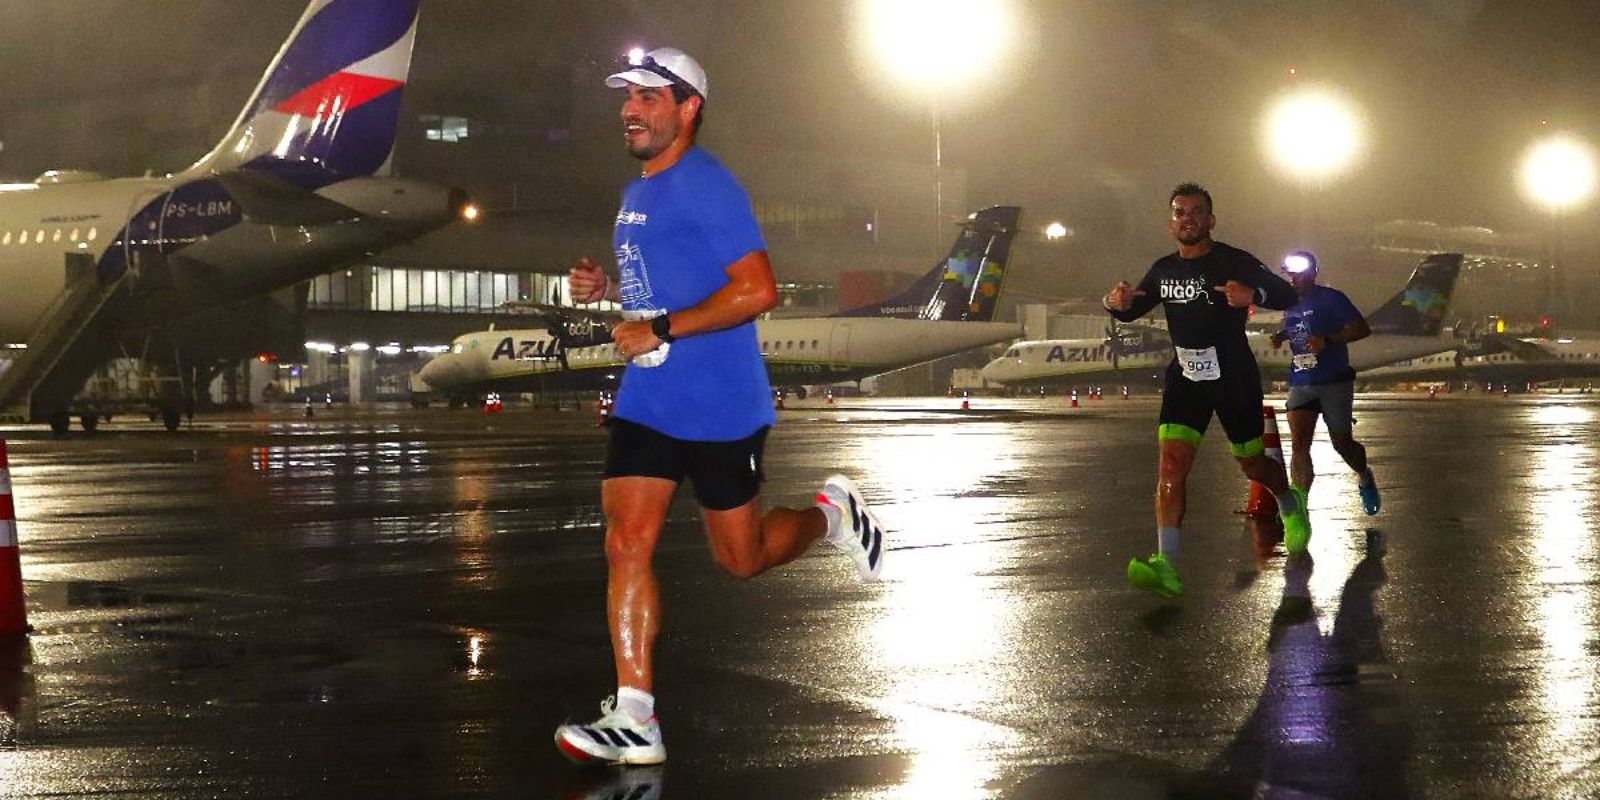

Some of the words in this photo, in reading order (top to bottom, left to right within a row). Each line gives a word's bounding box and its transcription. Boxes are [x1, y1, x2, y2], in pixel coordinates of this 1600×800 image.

[167, 201, 232, 218] PS-LBM
[1160, 284, 1195, 299] DIGO
[1045, 344, 1105, 363] Azul
[1187, 360, 1212, 371] 907
